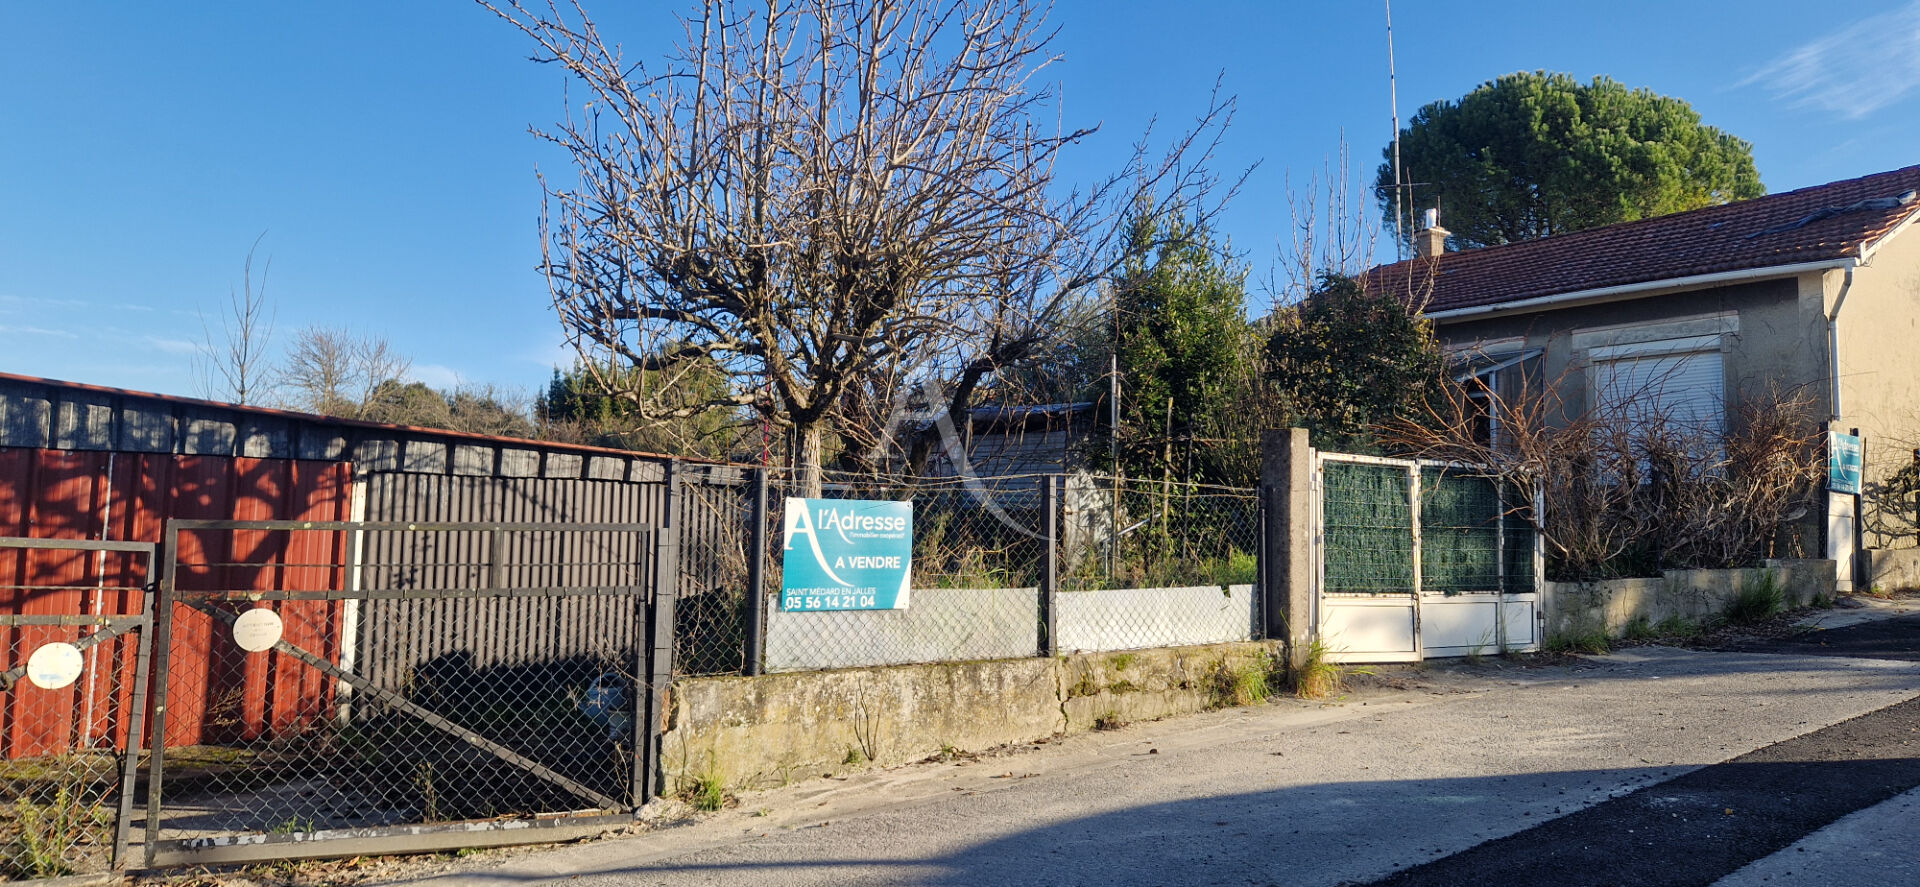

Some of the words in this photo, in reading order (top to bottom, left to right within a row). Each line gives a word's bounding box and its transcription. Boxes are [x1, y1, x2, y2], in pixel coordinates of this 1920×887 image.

[818, 507, 906, 545] l'Adresse
[835, 556, 845, 569] A
[849, 556, 901, 569] VENDRE
[786, 588, 808, 596] SAINT
[809, 586, 839, 596] MÉDARD
[853, 587, 876, 595] JALLES
[785, 597, 802, 609] 05
[805, 597, 821, 609] 56
[824, 597, 839, 608] 14
[842, 596, 855, 608] 21
[860, 596, 875, 607] 04
